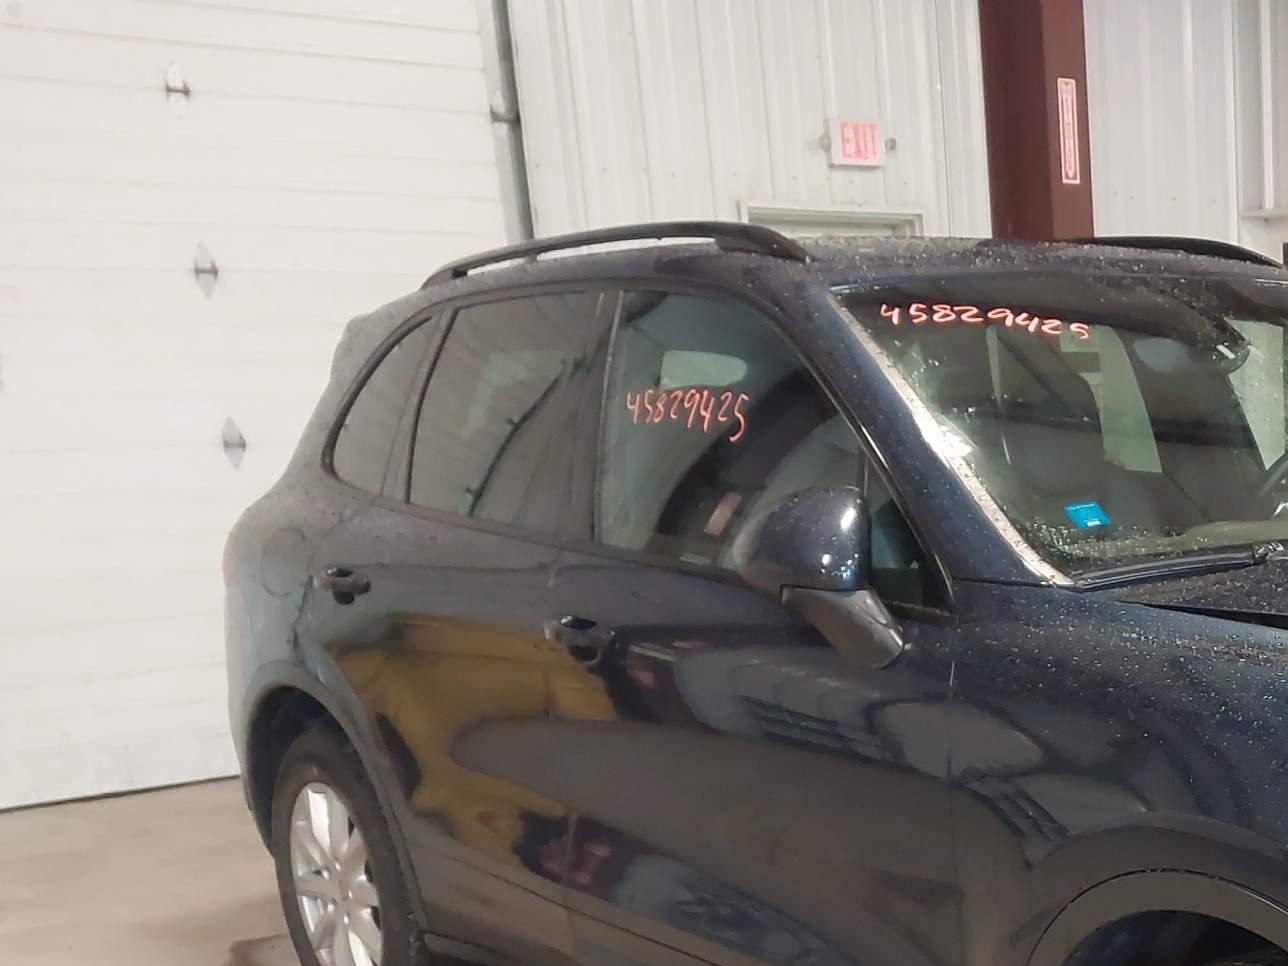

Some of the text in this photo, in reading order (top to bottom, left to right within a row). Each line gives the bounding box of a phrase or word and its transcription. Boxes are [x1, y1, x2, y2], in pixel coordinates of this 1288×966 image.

[841, 121, 877, 160] EXIT
[880, 303, 1090, 340] 45829425
[626, 388, 749, 442] 45829425
